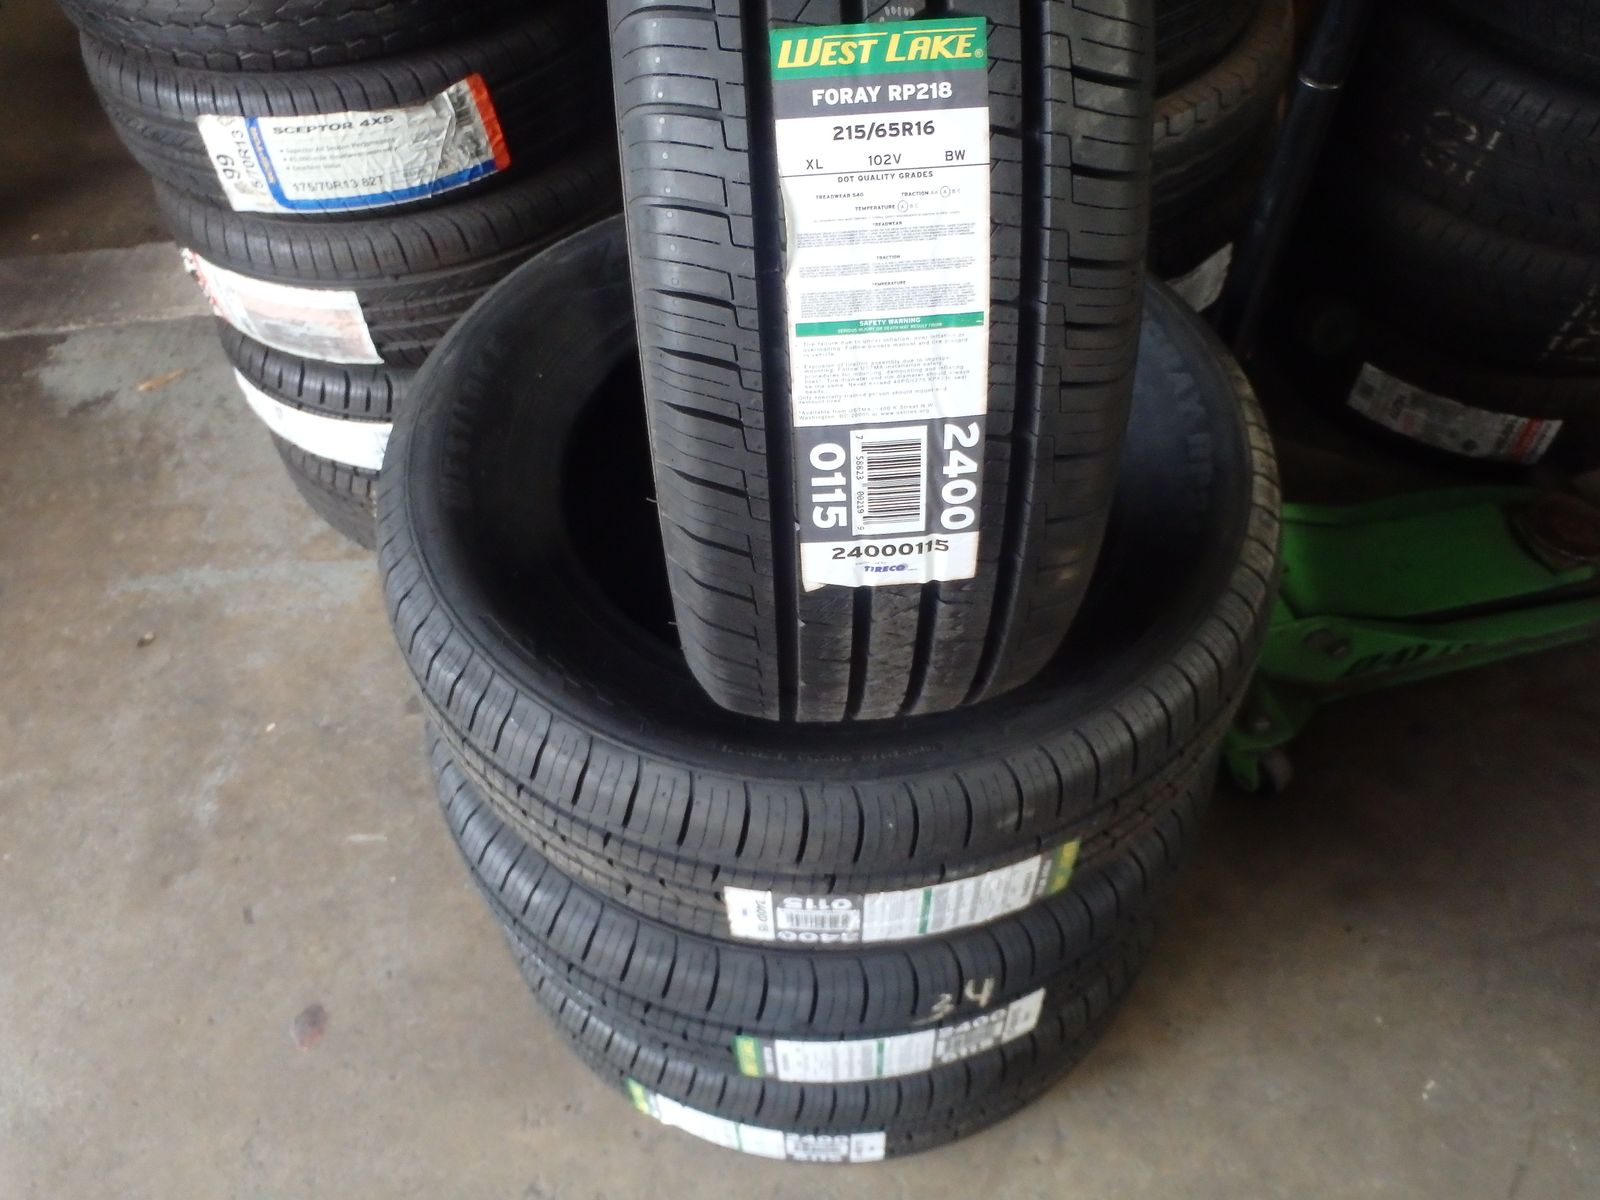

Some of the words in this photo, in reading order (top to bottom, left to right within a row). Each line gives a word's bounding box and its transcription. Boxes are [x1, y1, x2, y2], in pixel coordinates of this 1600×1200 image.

[777, 34, 884, 68] WEST
[885, 28, 977, 63] LAKE
[812, 86, 881, 106] FORAY
[888, 82, 953, 101] RP218
[272, 122, 355, 136] SCEPTOR
[359, 115, 395, 128] 4XS
[832, 120, 935, 141] 215/65R16
[806, 159, 823, 171] XL
[868, 154, 901, 166] 102V
[945, 150, 966, 162] BW
[361, 175, 384, 186] 82T
[838, 175, 855, 183] DOT
[858, 172, 895, 182] QUALITY
[898, 170, 933, 180] GRADES
[855, 204, 896, 212] TEMPERATURE
[860, 319, 886, 327] SAFETY
[888, 317, 921, 325] WARNING
[809, 443, 847, 529] 0115
[941, 422, 980, 530] 2400
[832, 540, 949, 560] 24000115
[864, 563, 907, 573] TIRECO
